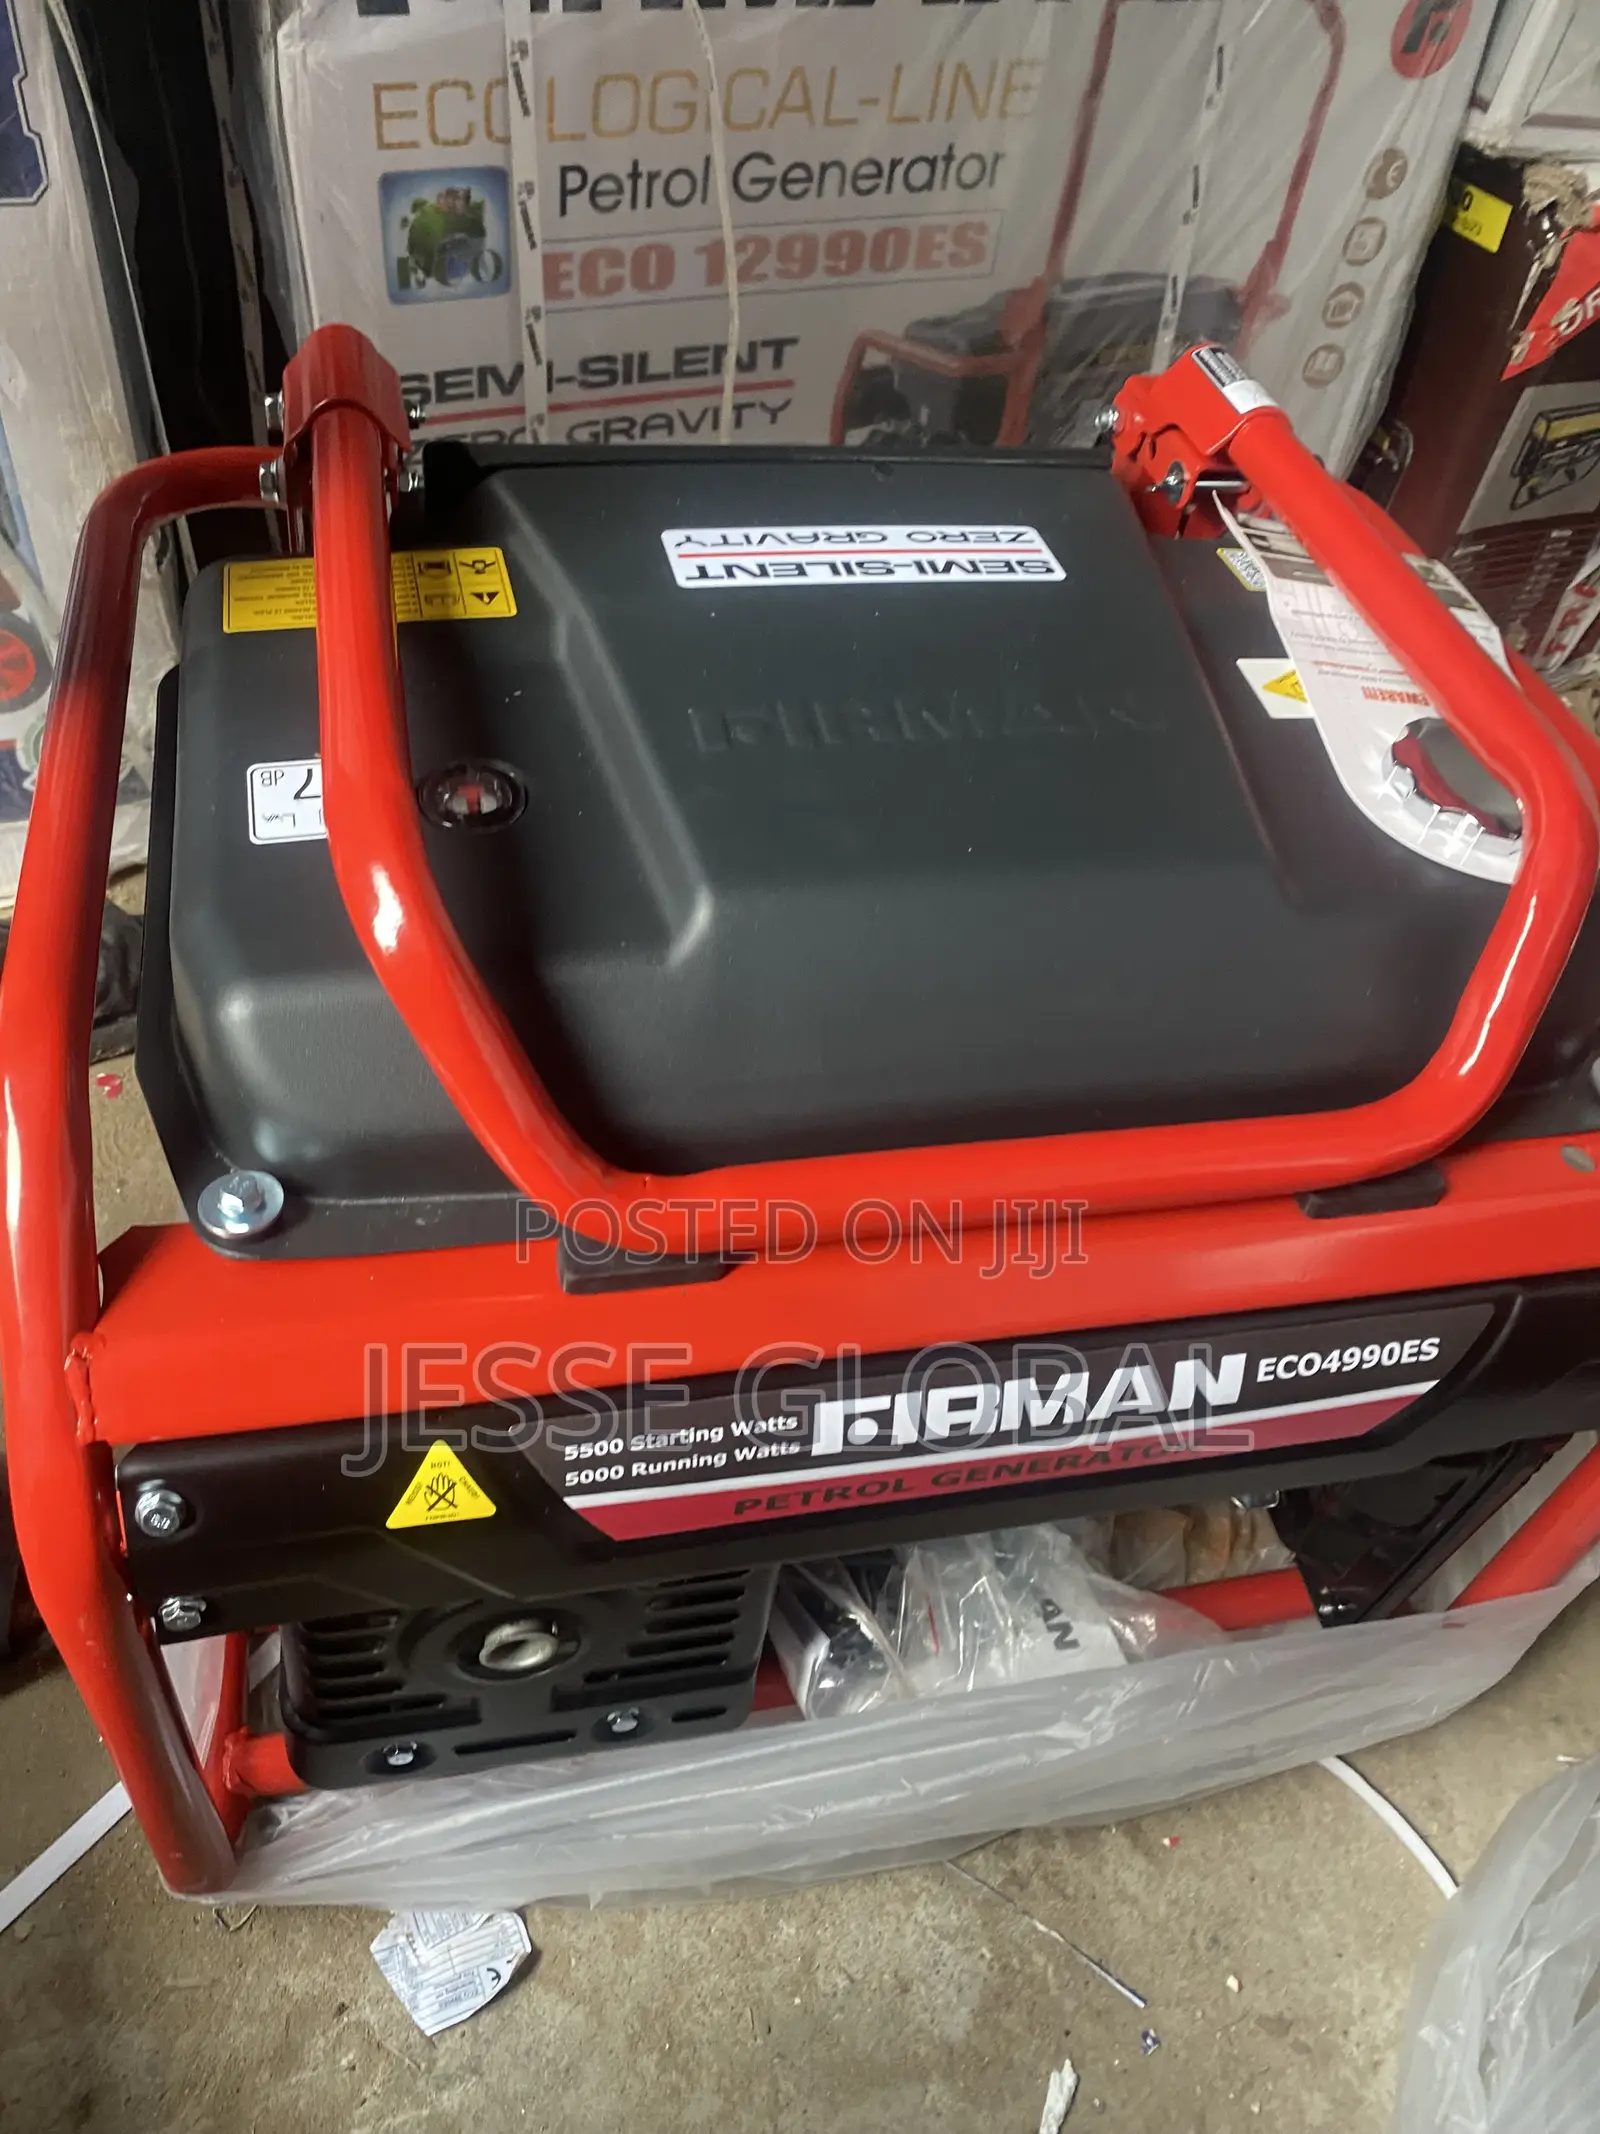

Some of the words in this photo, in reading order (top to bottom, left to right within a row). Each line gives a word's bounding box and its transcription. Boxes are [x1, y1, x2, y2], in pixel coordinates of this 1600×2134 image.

[560, 155, 712, 217] Petrol
[732, 143, 1006, 203] Generator
[543, 244, 676, 300] ECO
[694, 220, 989, 287] 12990ES
[566, 398, 793, 448] GRAVITY
[673, 530, 888, 548] GRAVITY
[905, 530, 1035, 546] ZERO
[684, 559, 1057, 581] SEMI-SILENT
[260, 769, 285, 787] dB
[293, 768, 321, 801] 7
[811, 1352, 1248, 1456] FIRMAN
[1255, 1336, 1442, 1383] ECO4990ES
[564, 1437, 624, 1462] 5500
[630, 1423, 724, 1452] Starting
[730, 1413, 798, 1438] Watts
[564, 1464, 624, 1487] 5000
[630, 1450, 727, 1478] Running
[733, 1440, 801, 1463] Watts
[733, 1476, 906, 1516] PETROL
